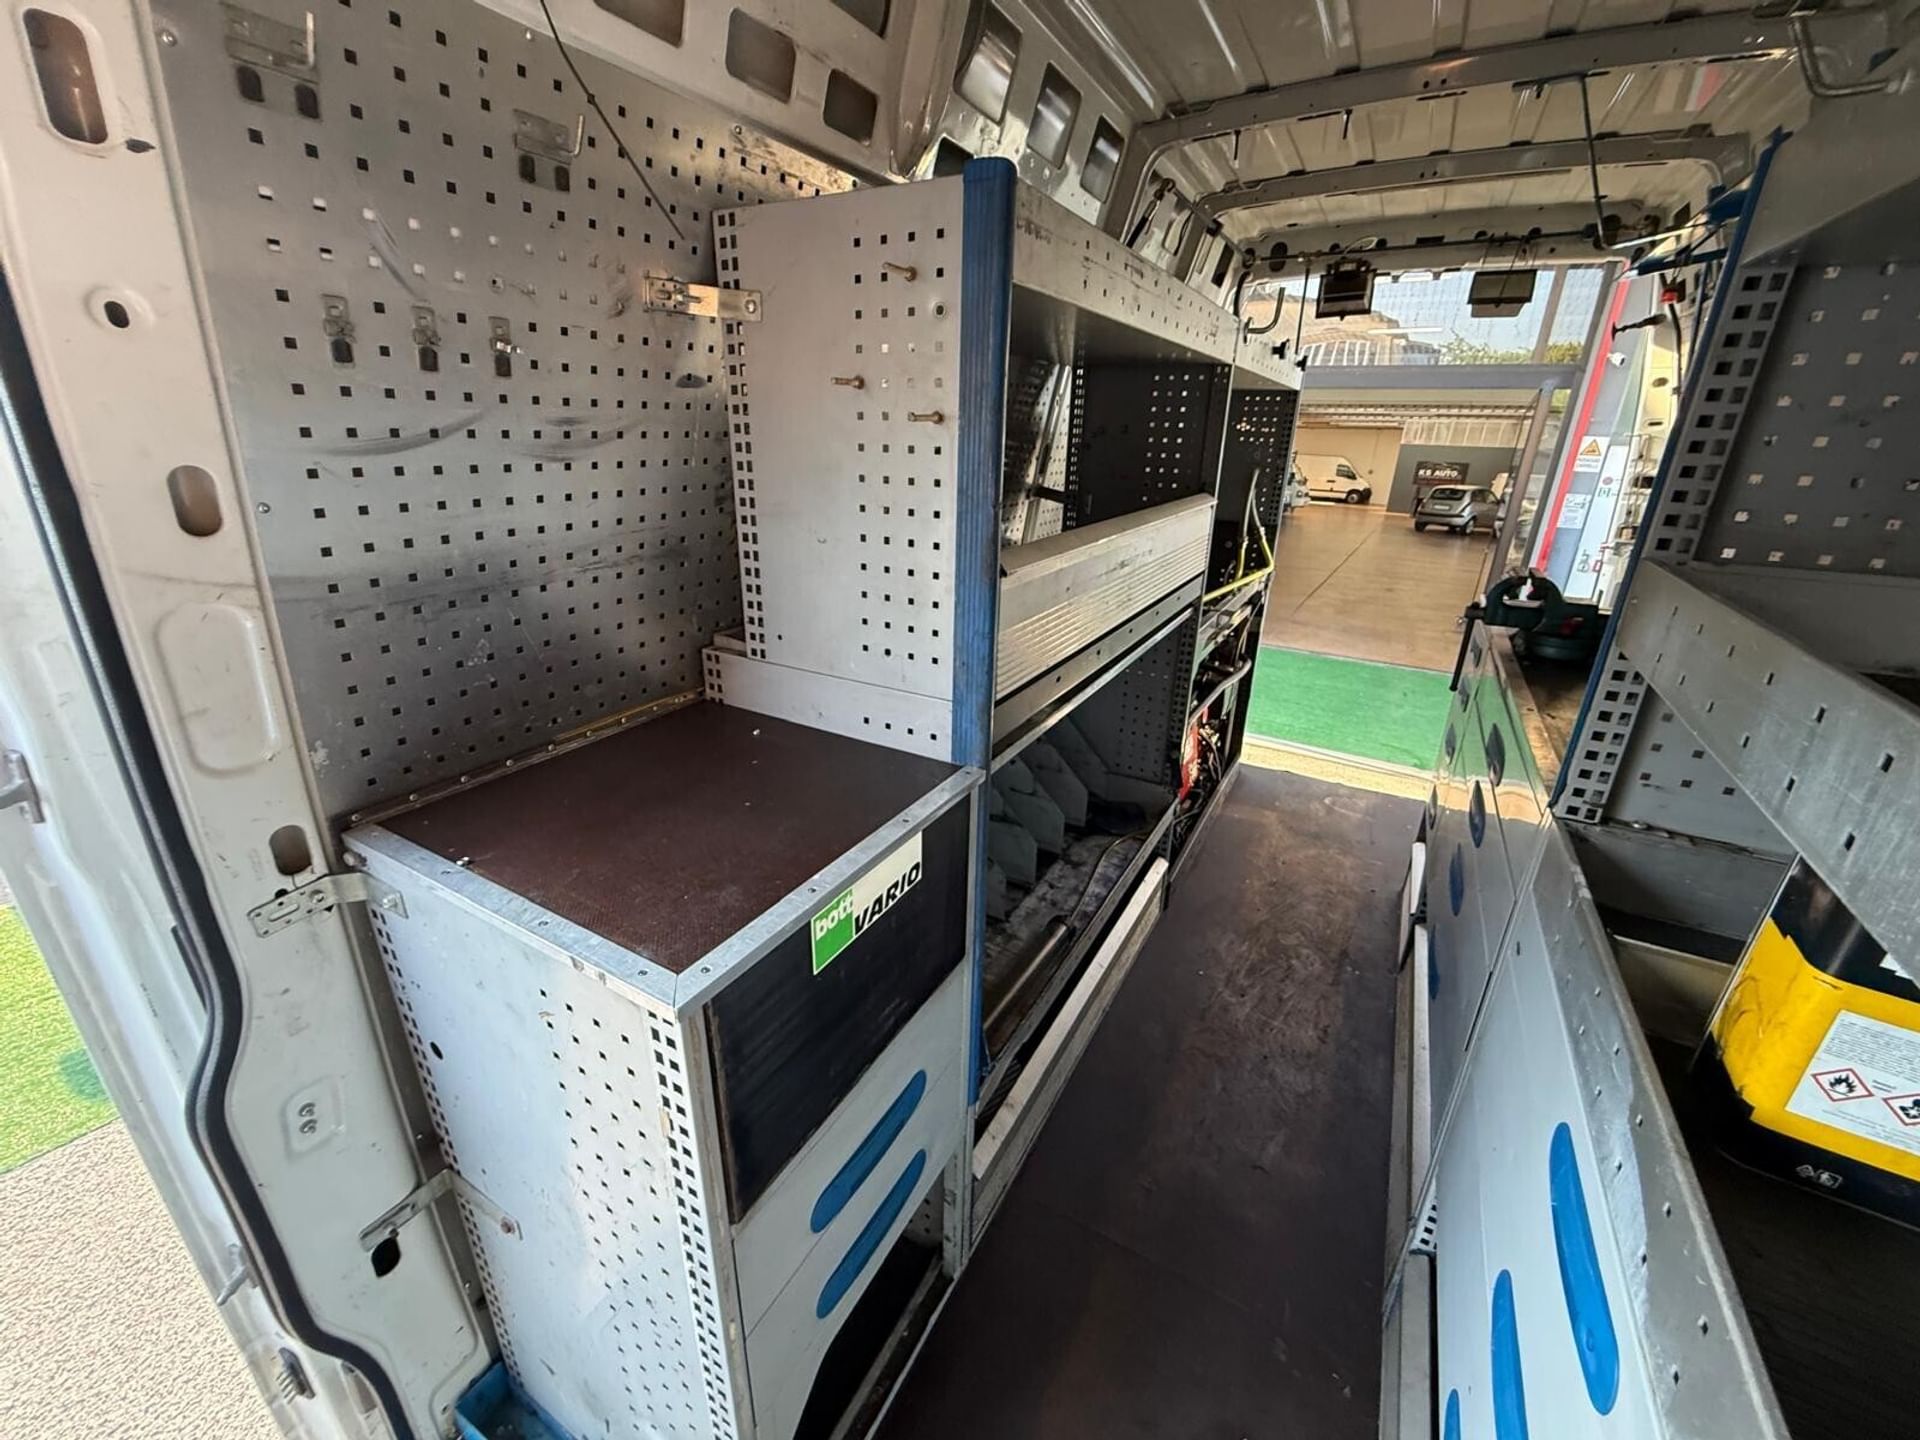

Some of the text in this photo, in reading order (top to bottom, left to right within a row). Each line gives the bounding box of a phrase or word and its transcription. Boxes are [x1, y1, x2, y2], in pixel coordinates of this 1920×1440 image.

[1433, 469, 1458, 478] AUTO
[815, 892, 854, 941] bott
[854, 861, 921, 936] VARIO
